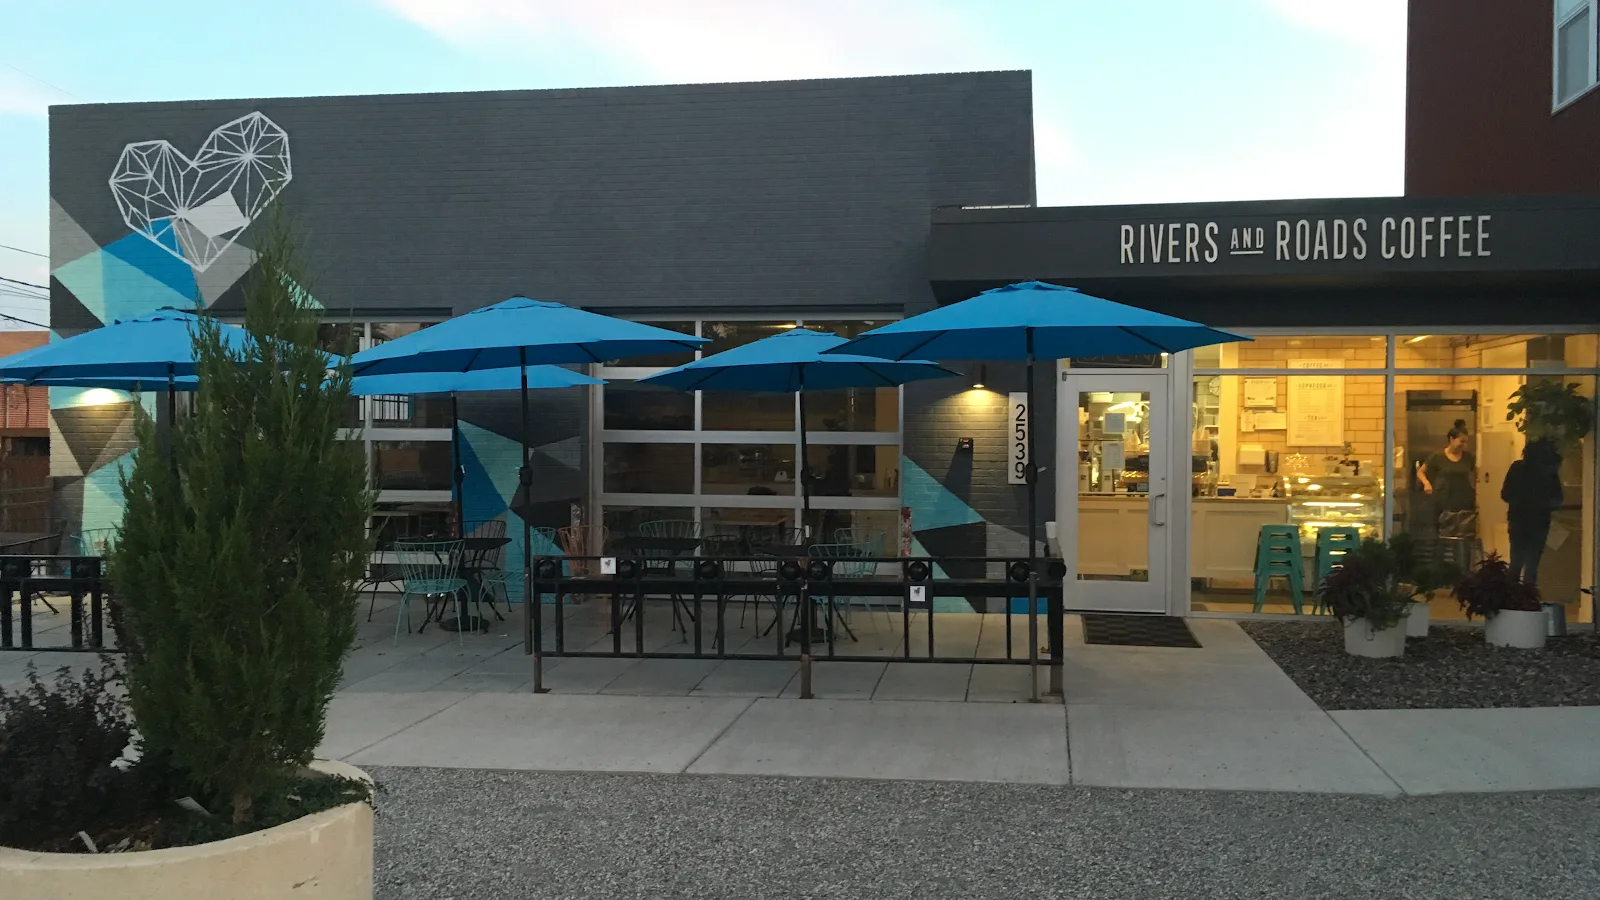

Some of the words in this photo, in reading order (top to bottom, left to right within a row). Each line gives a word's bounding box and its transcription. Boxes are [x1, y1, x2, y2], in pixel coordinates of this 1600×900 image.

[1120, 222, 1219, 264] RIVERS
[1230, 228, 1264, 250] AND
[1275, 217, 1368, 261] ROADS
[1381, 214, 1492, 260] COFFEE
[1015, 404, 1026, 480] 2539
